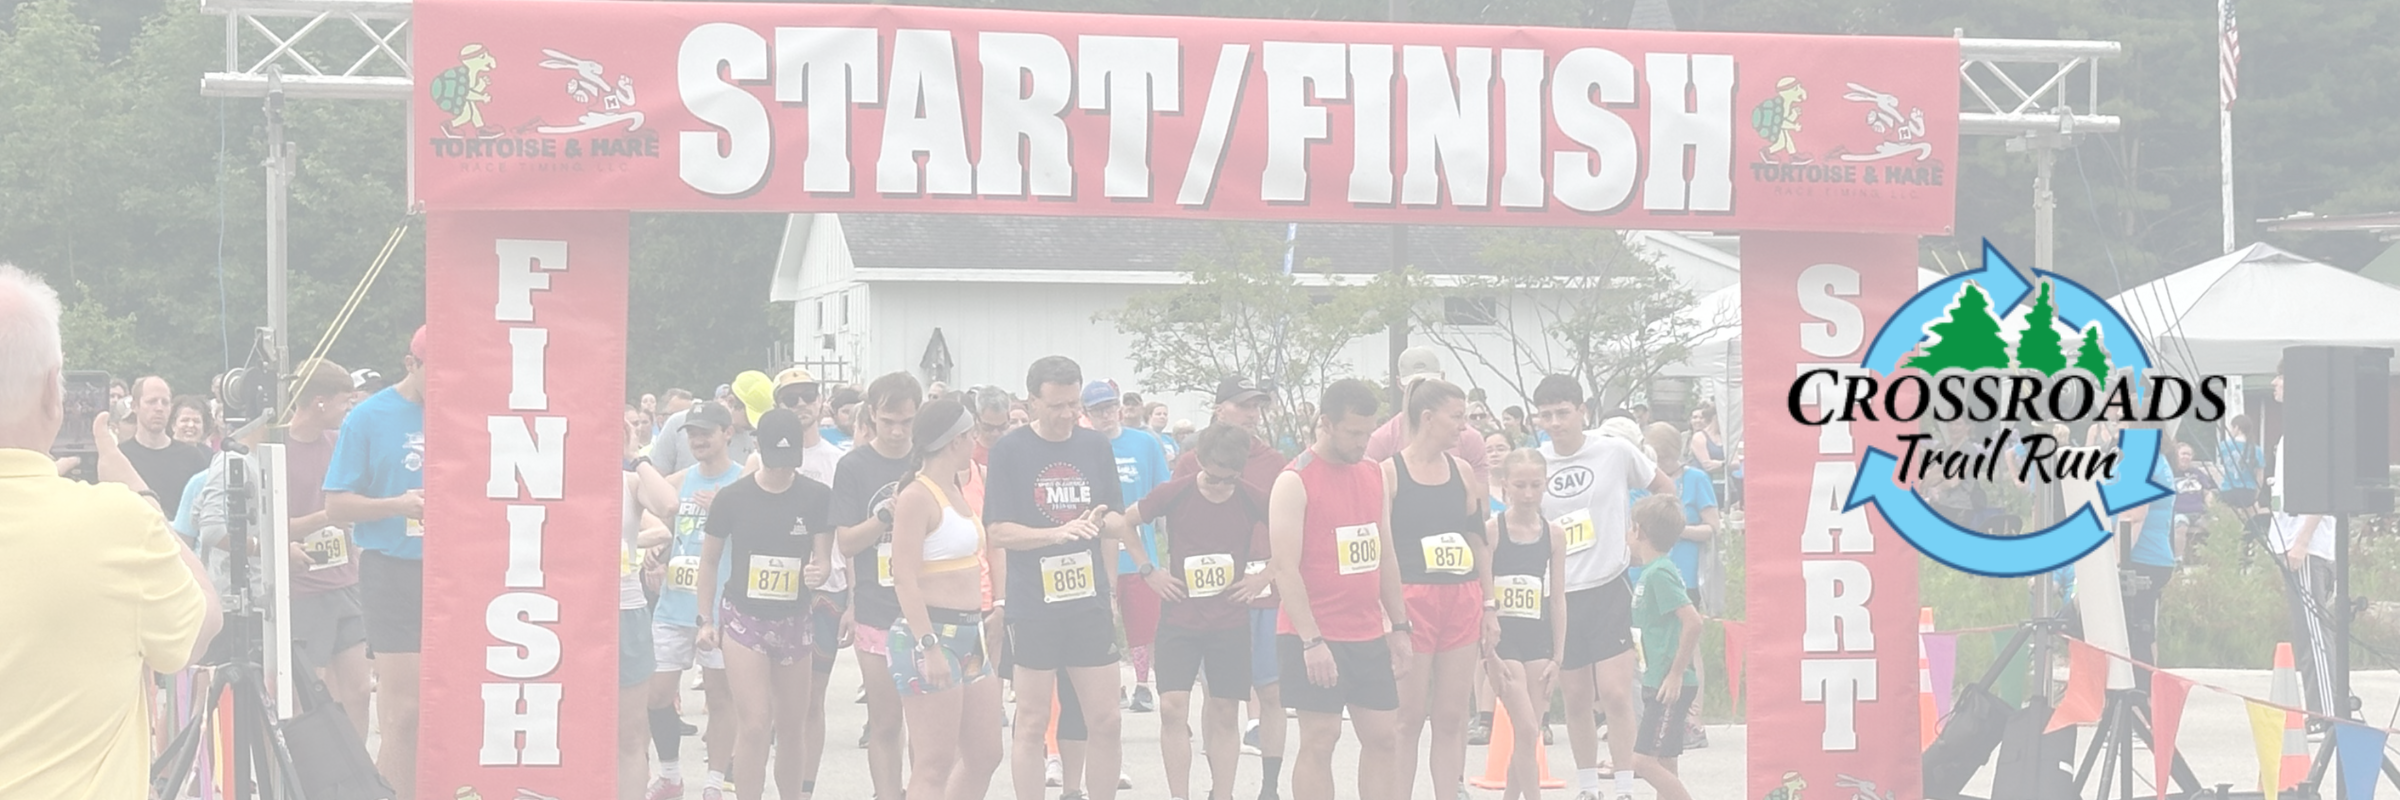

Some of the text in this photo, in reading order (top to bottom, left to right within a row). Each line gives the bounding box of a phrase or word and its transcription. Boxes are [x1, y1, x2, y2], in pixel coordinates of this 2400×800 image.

[677, 22, 1738, 213] START/FINISH
[429, 137, 659, 159] TORTOISE & HARE
[460, 162, 506, 173] RACE
[597, 162, 628, 173] LLC
[1750, 163, 1944, 187] TORTOISE & HARE
[1774, 186, 1813, 197] RACE
[1554, 471, 1586, 491] SAV
[478, 239, 570, 767] FINISH
[1046, 486, 1091, 504] MILE
[1349, 539, 1377, 564] 808
[1434, 546, 1463, 566] 857
[675, 566, 698, 586] 86
[759, 569, 790, 591] 871
[1053, 567, 1087, 592] 865
[1194, 566, 1226, 588] 848
[1503, 588, 1534, 609] 856
